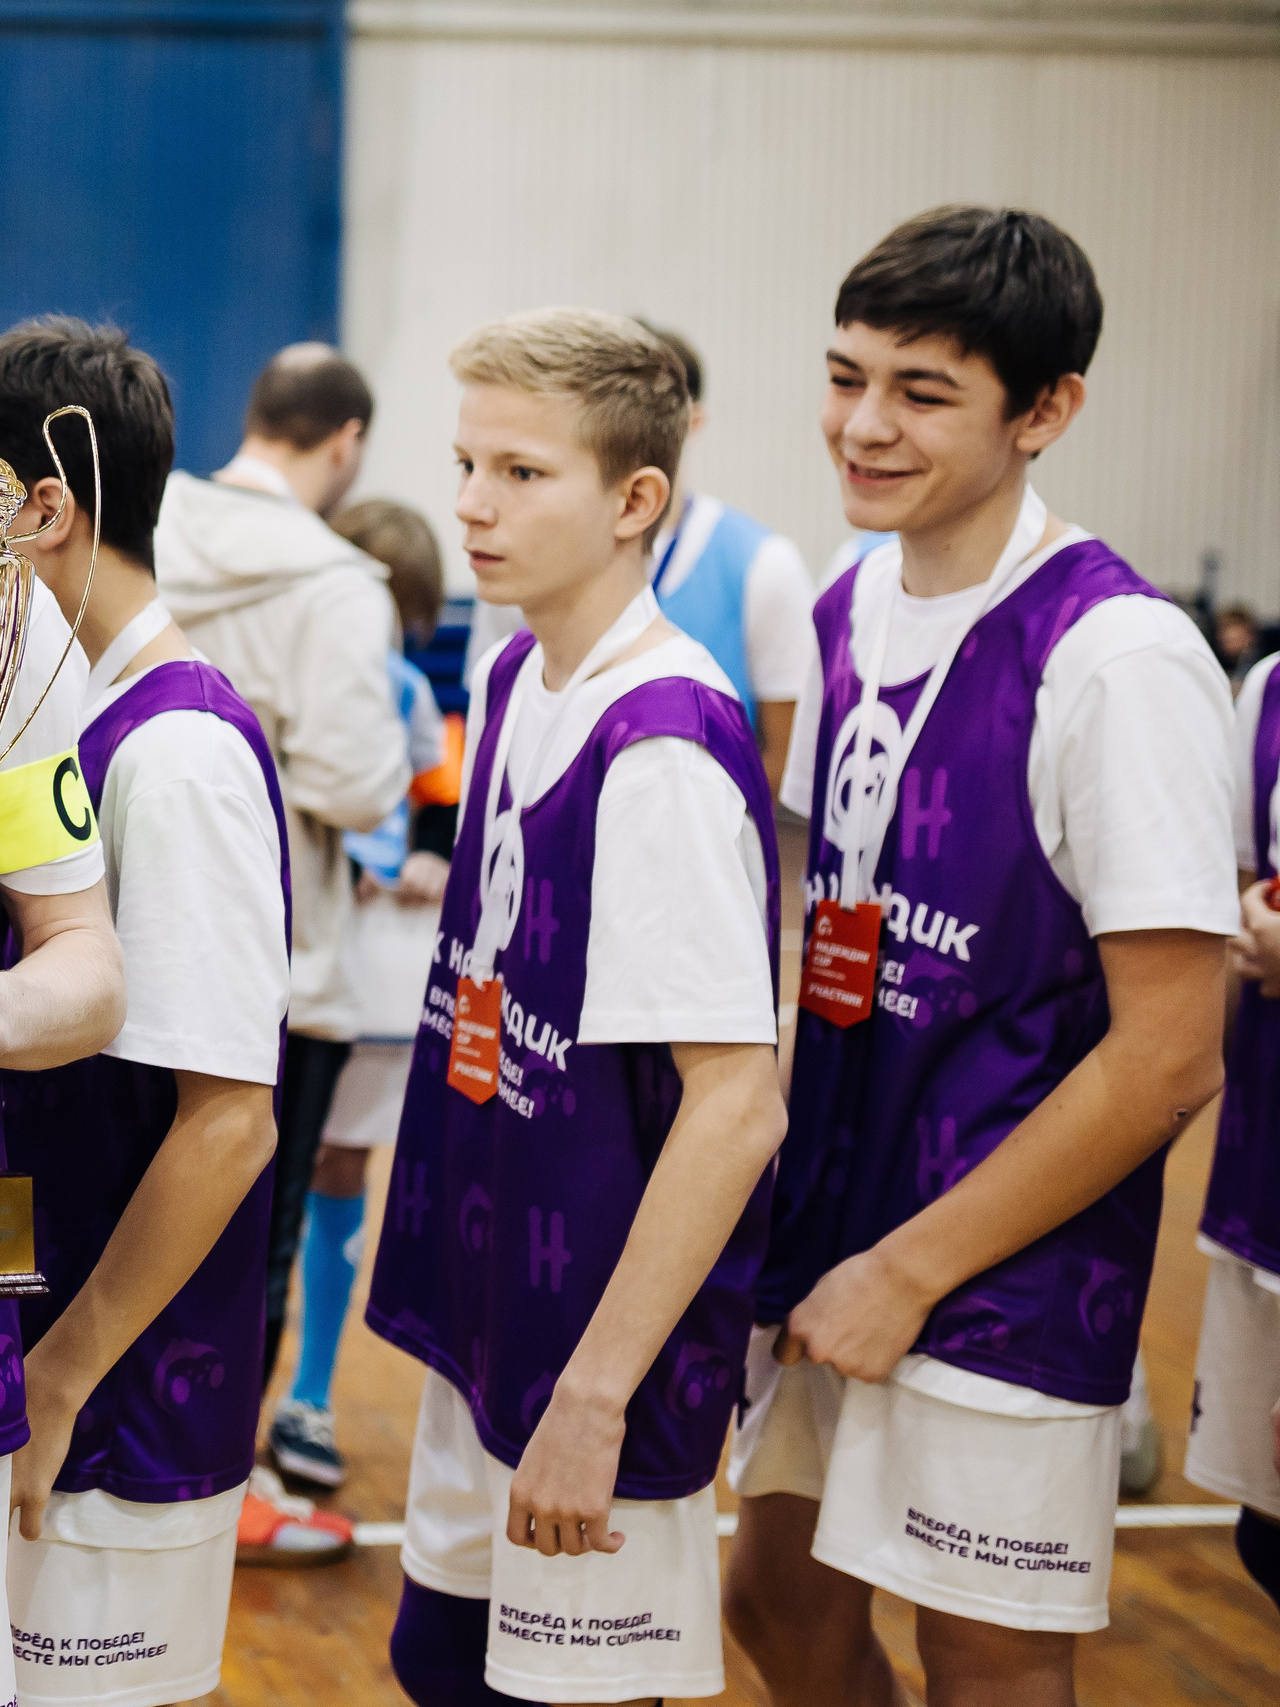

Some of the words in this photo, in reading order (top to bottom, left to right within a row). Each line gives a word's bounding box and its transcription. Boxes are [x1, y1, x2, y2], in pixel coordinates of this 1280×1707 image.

[53, 756, 92, 841] C
[907, 1508, 972, 1543] ВПЕРЁД
[978, 1534, 989, 1546] К
[996, 1537, 1069, 1555] ПОБЕДЕ!
[905, 1524, 968, 1557] ВМЕСТЕ
[975, 1550, 1008, 1566] МЫ
[1015, 1557, 1091, 1573] СИЛЬНЕЕ!
[500, 1604, 566, 1629] ВПЕРЁД
[572, 1618, 583, 1629] К
[61, 1639, 72, 1650] К
[77, 1632, 145, 1650] ПОБЕДЕ!
[499, 1620, 565, 1645] ВМЕСТЕ
[570, 1635, 600, 1646] МЫ
[606, 1629, 681, 1646] СИЛЬНЕЕ!
[59, 1655, 89, 1666] МЫ
